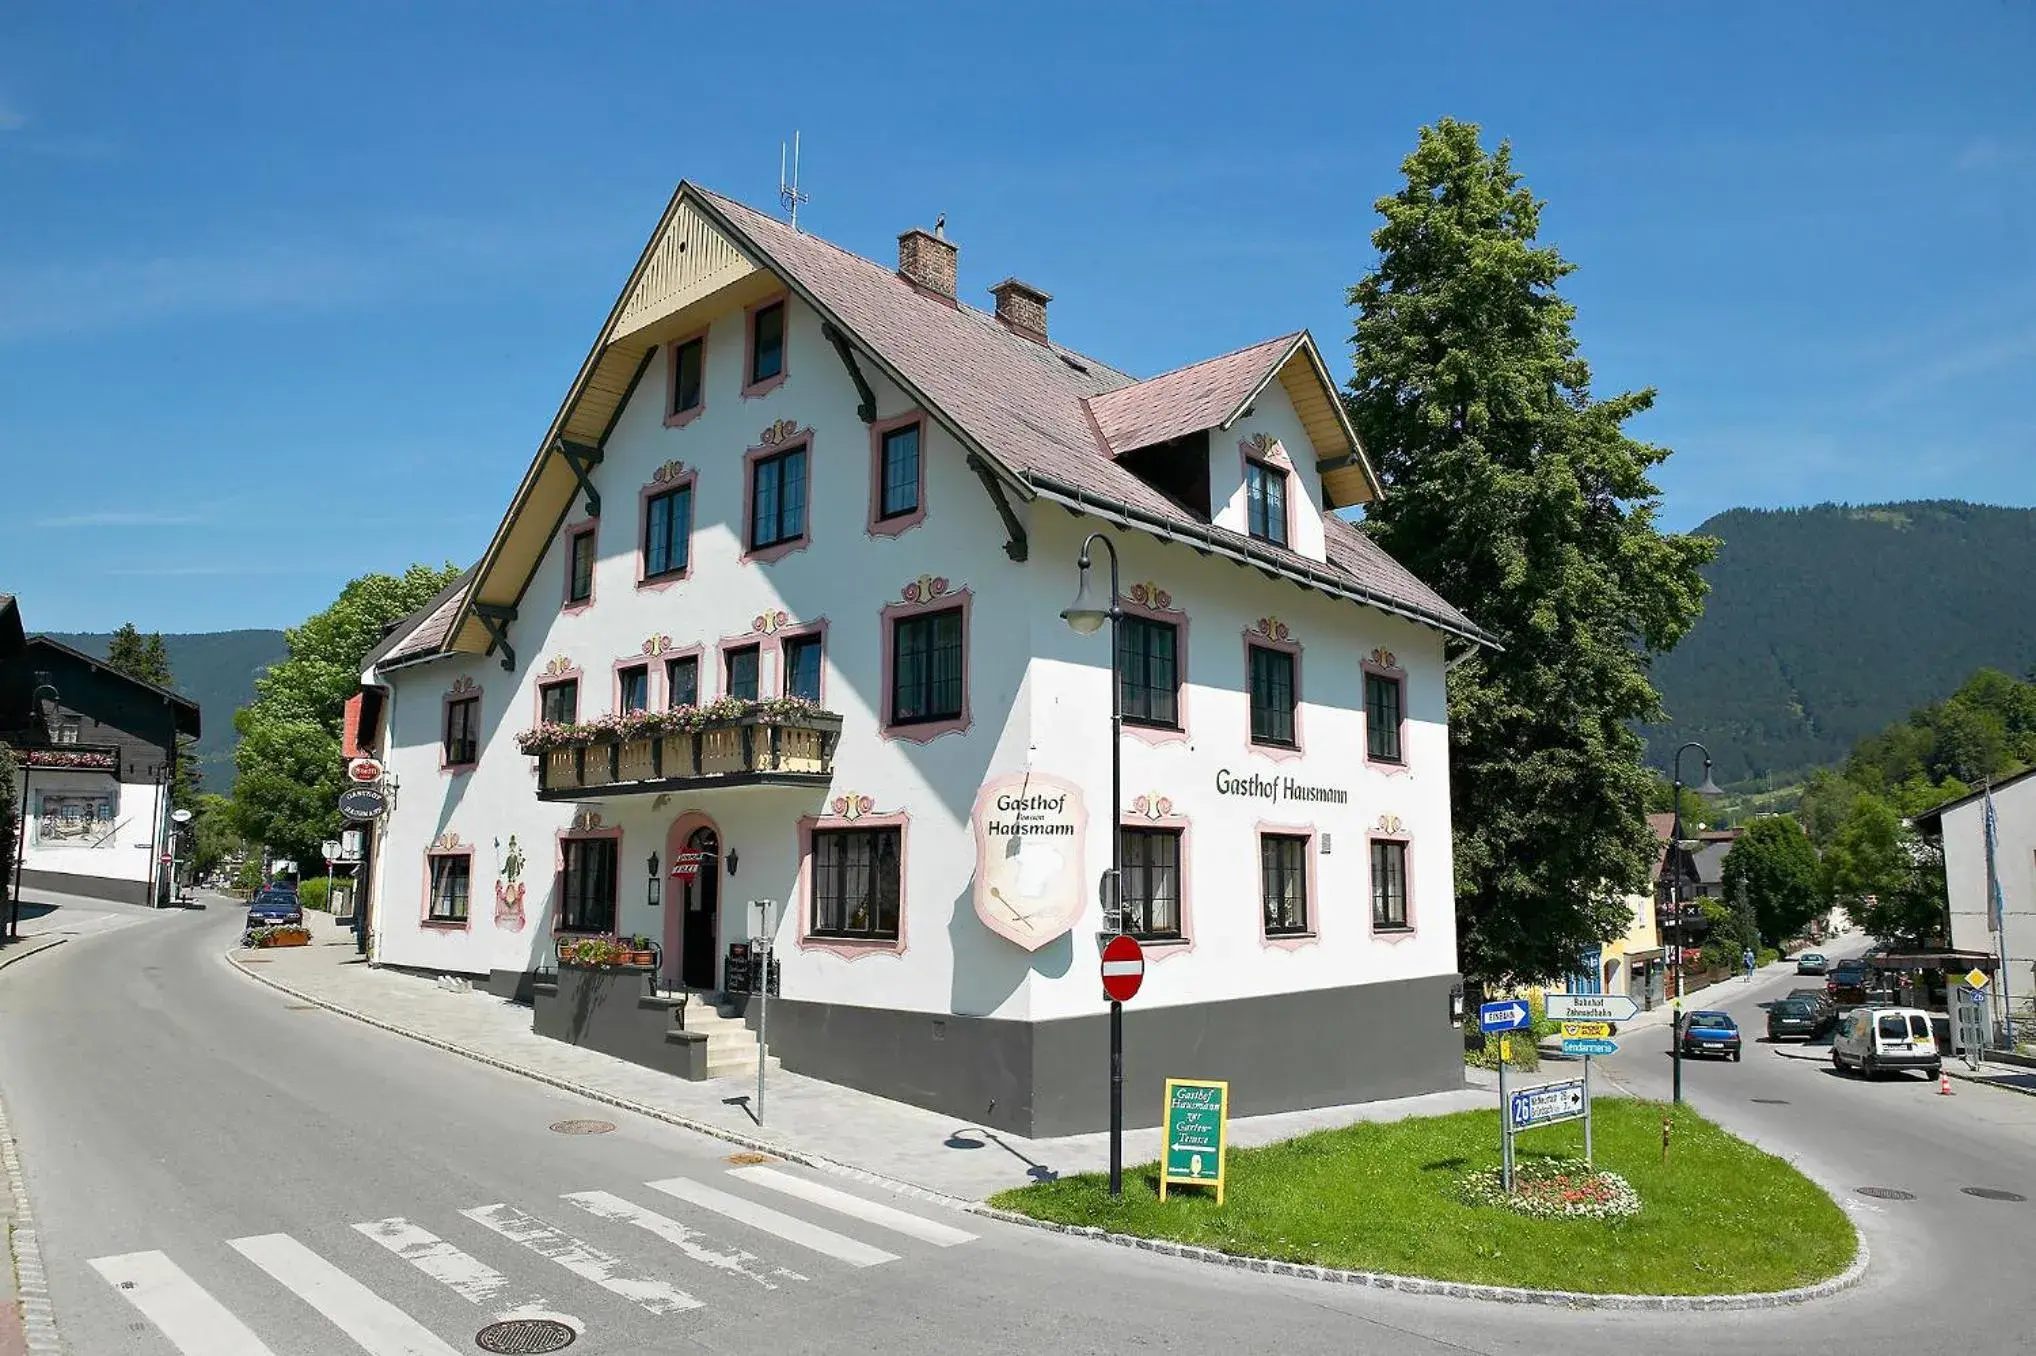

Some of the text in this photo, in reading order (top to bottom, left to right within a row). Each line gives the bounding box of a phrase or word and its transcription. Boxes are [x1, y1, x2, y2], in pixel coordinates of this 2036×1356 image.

[1216, 768, 1348, 804] Gasthof Hausmann
[996, 793, 1066, 815] Gasthof
[988, 821, 1075, 837] Hausmann
[1574, 998, 1604, 1007] Bahnhof
[1176, 1088, 1214, 1103] Gasthof
[1171, 1098, 1220, 1111] Hausmann
[1515, 1098, 1529, 1121] 26
